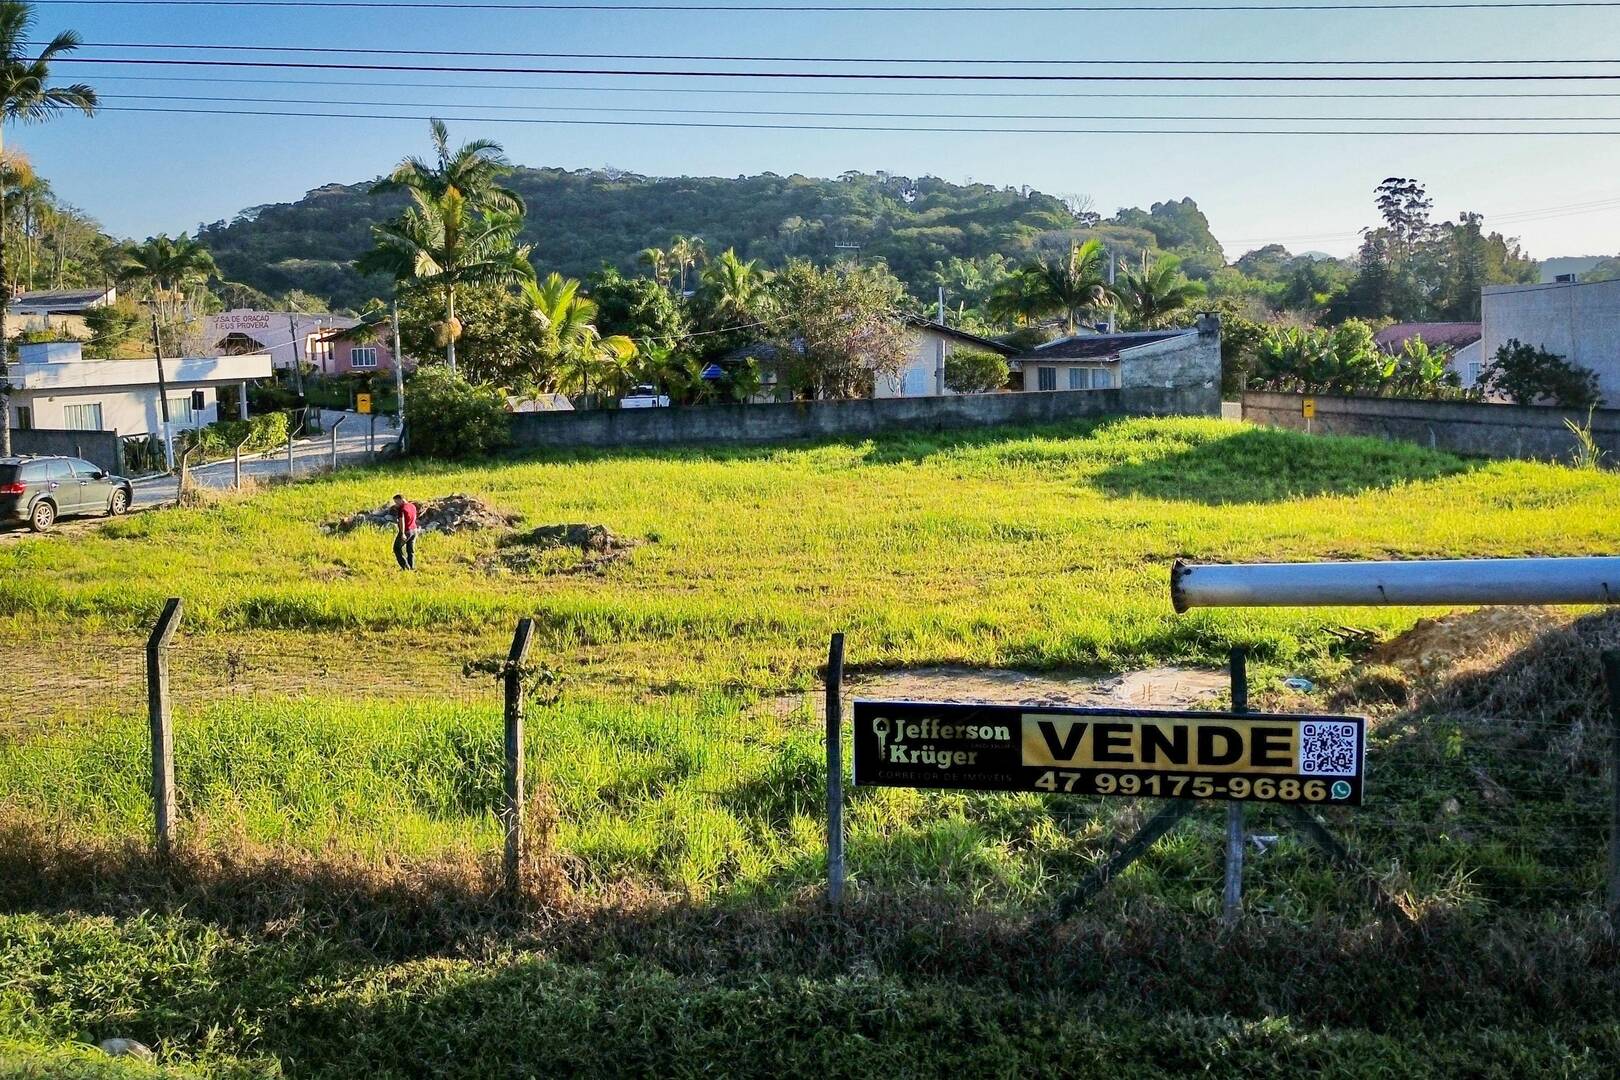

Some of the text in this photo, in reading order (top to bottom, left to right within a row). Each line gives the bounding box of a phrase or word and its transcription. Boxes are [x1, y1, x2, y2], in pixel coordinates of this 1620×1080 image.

[894, 718, 1010, 742] Jefferson
[890, 744, 978, 769] Krüger
[1038, 721, 1293, 768] VENDE
[1034, 771, 1326, 801] 47 99175-9686
